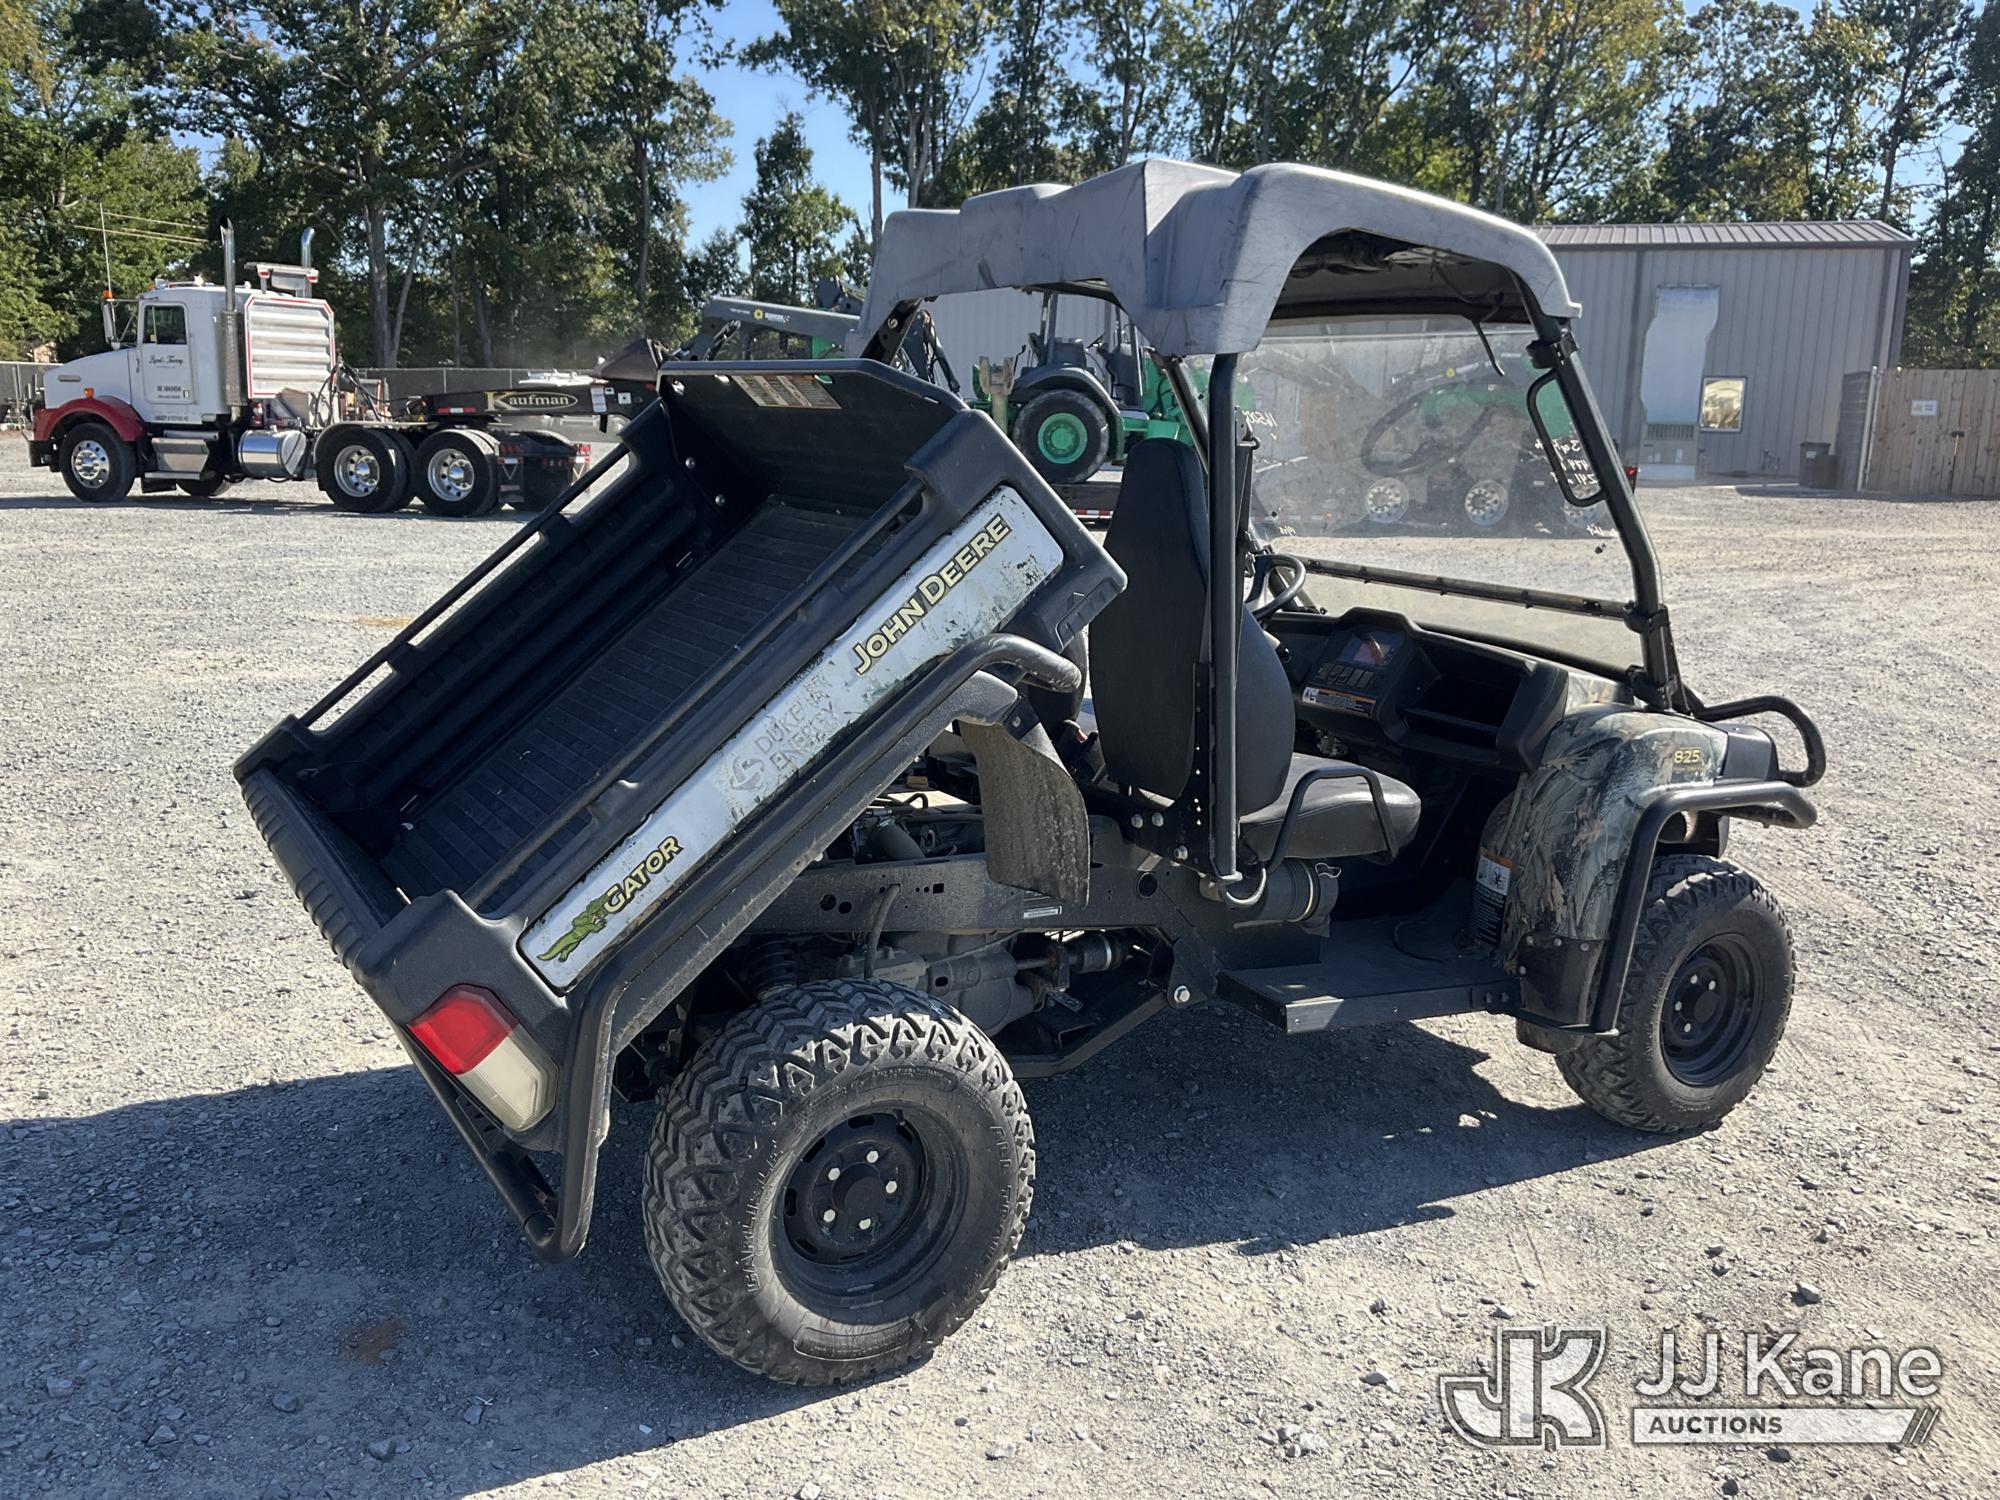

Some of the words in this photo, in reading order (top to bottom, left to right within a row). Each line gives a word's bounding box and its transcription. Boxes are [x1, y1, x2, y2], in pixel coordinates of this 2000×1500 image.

[484, 391, 570, 411] Kaufman
[852, 597, 926, 676] JOHN
[917, 513, 1013, 606] DEERE
[1673, 749, 1701, 764] 825
[603, 836, 684, 914] GATOR
